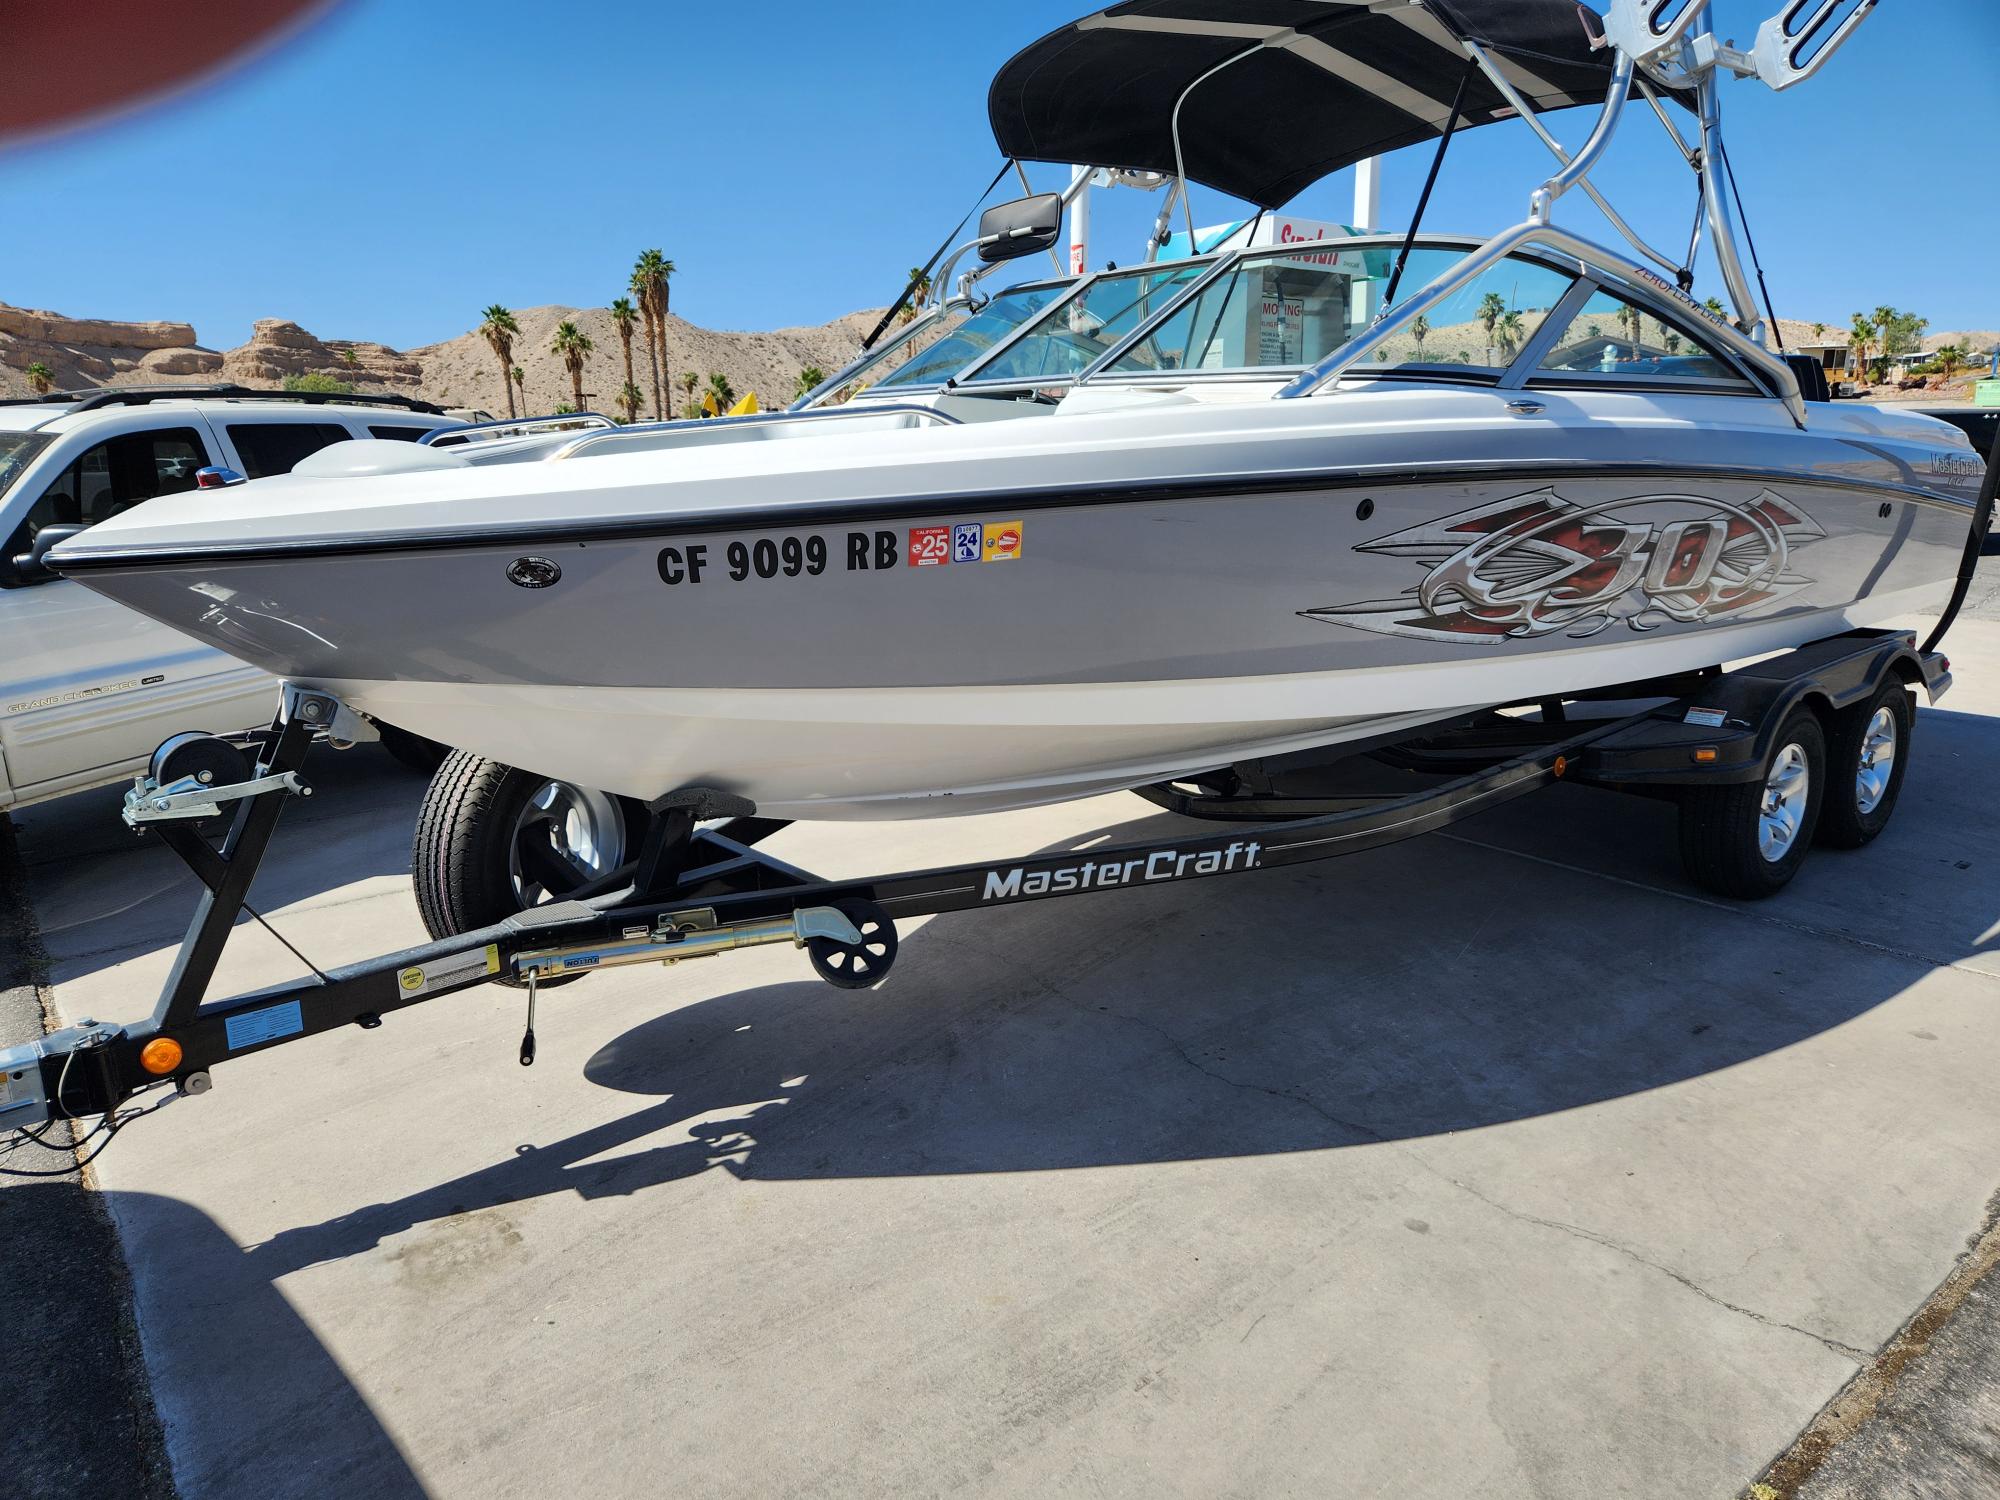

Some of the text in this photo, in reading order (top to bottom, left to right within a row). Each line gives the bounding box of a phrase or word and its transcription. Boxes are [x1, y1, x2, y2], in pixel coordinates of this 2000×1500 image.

[921, 534, 949, 558] 25
[957, 532, 978, 548] 24
[656, 531, 898, 586] CF 9099 RB
[8, 696, 61, 714] GRAND
[63, 679, 138, 702] CHEROKEE
[982, 841, 1261, 901] MasterCraft
